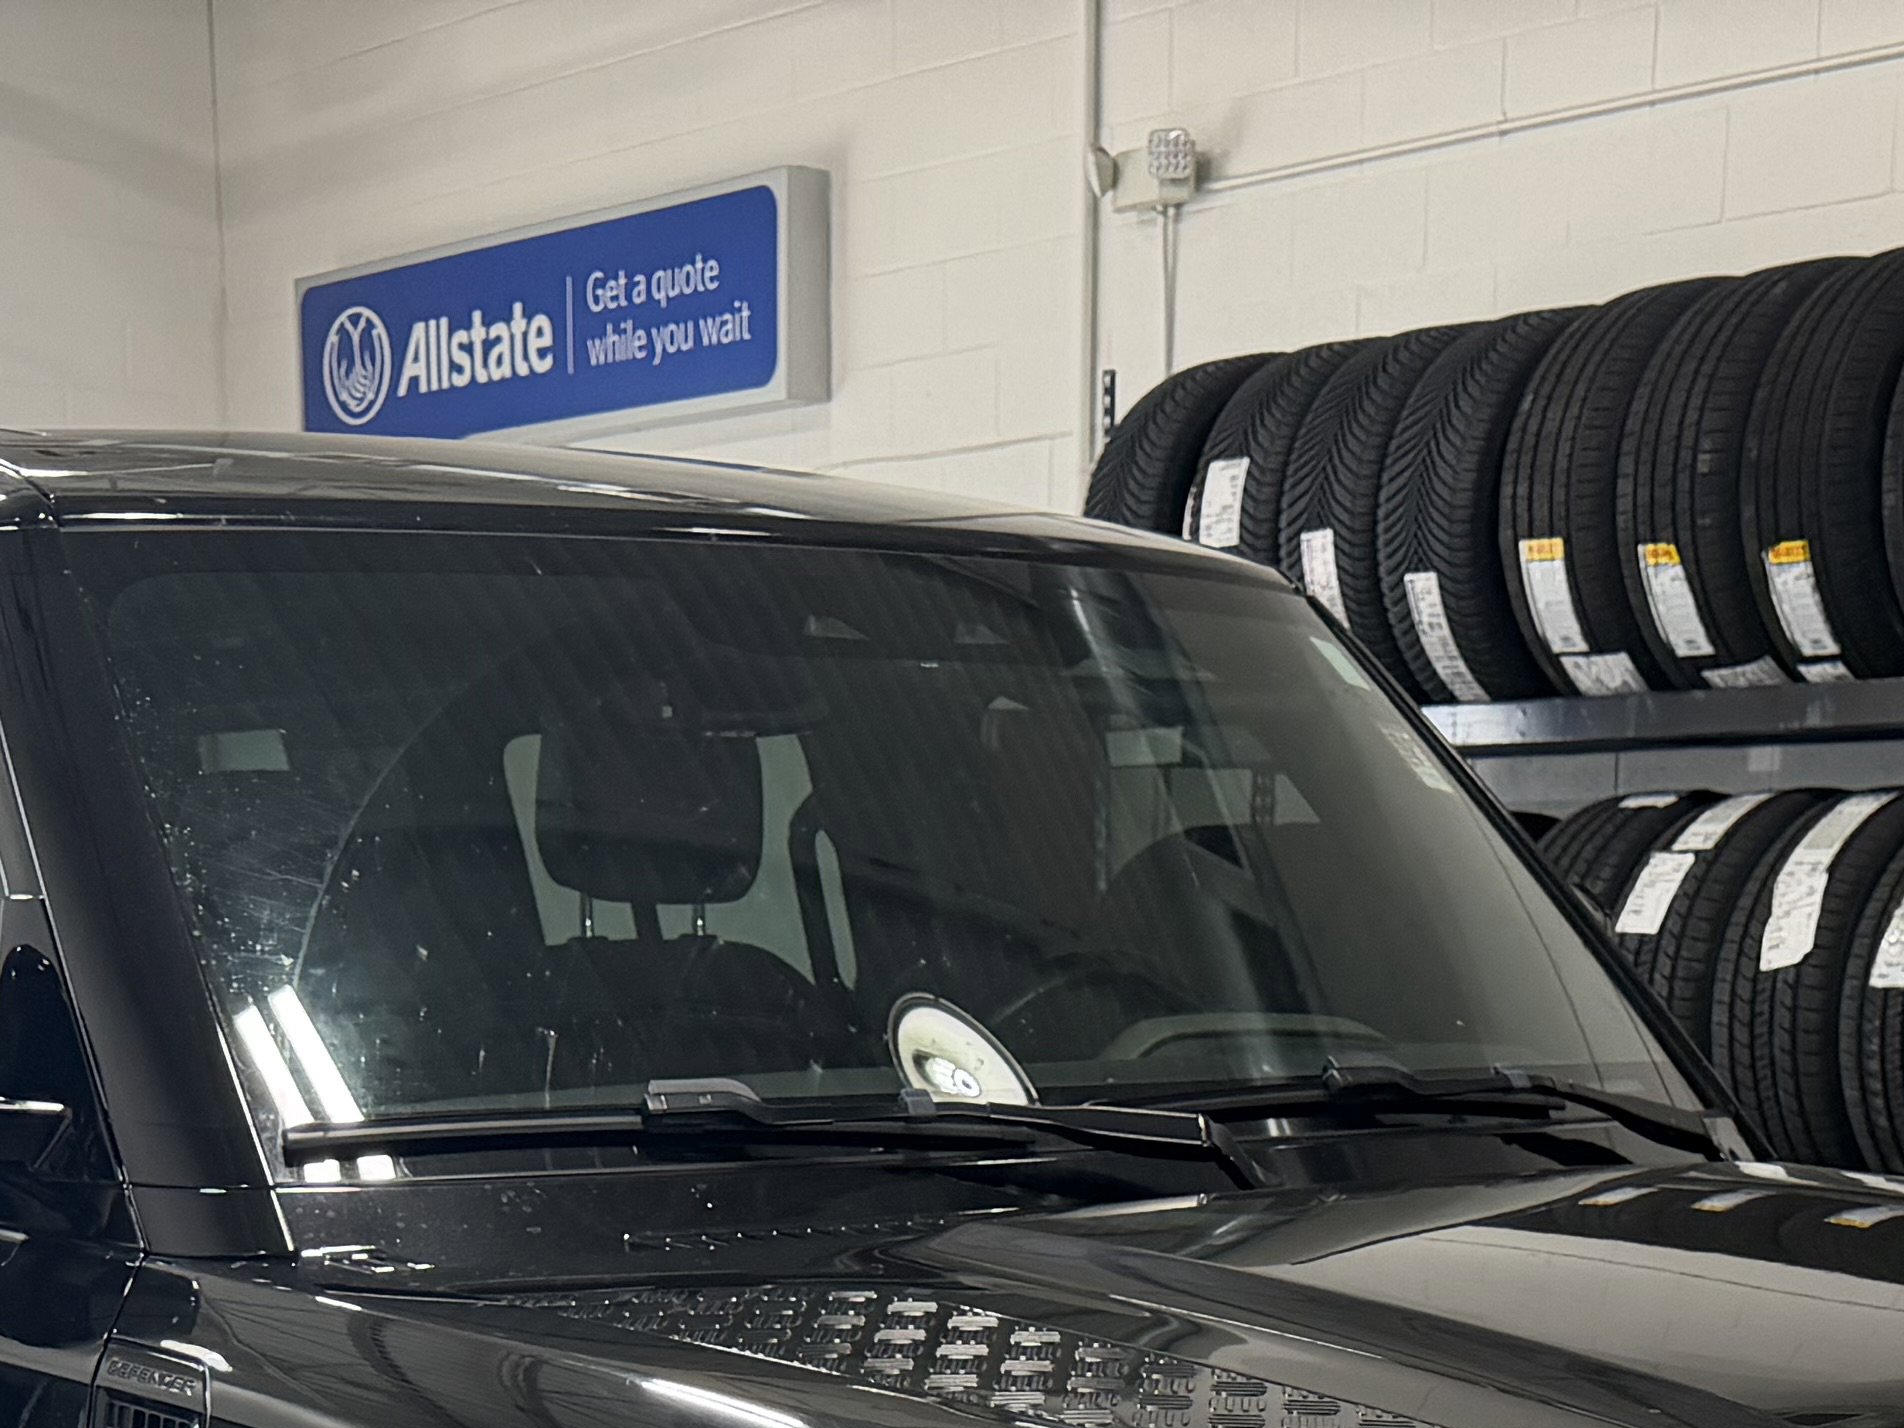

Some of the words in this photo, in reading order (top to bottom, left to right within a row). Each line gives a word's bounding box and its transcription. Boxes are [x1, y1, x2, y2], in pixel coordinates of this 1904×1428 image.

[585, 270, 628, 313] Get
[632, 274, 647, 304] a
[651, 254, 721, 308] quote
[397, 301, 554, 397] Allstate
[586, 319, 648, 367] while
[651, 320, 694, 365] you
[699, 301, 753, 346] wait
